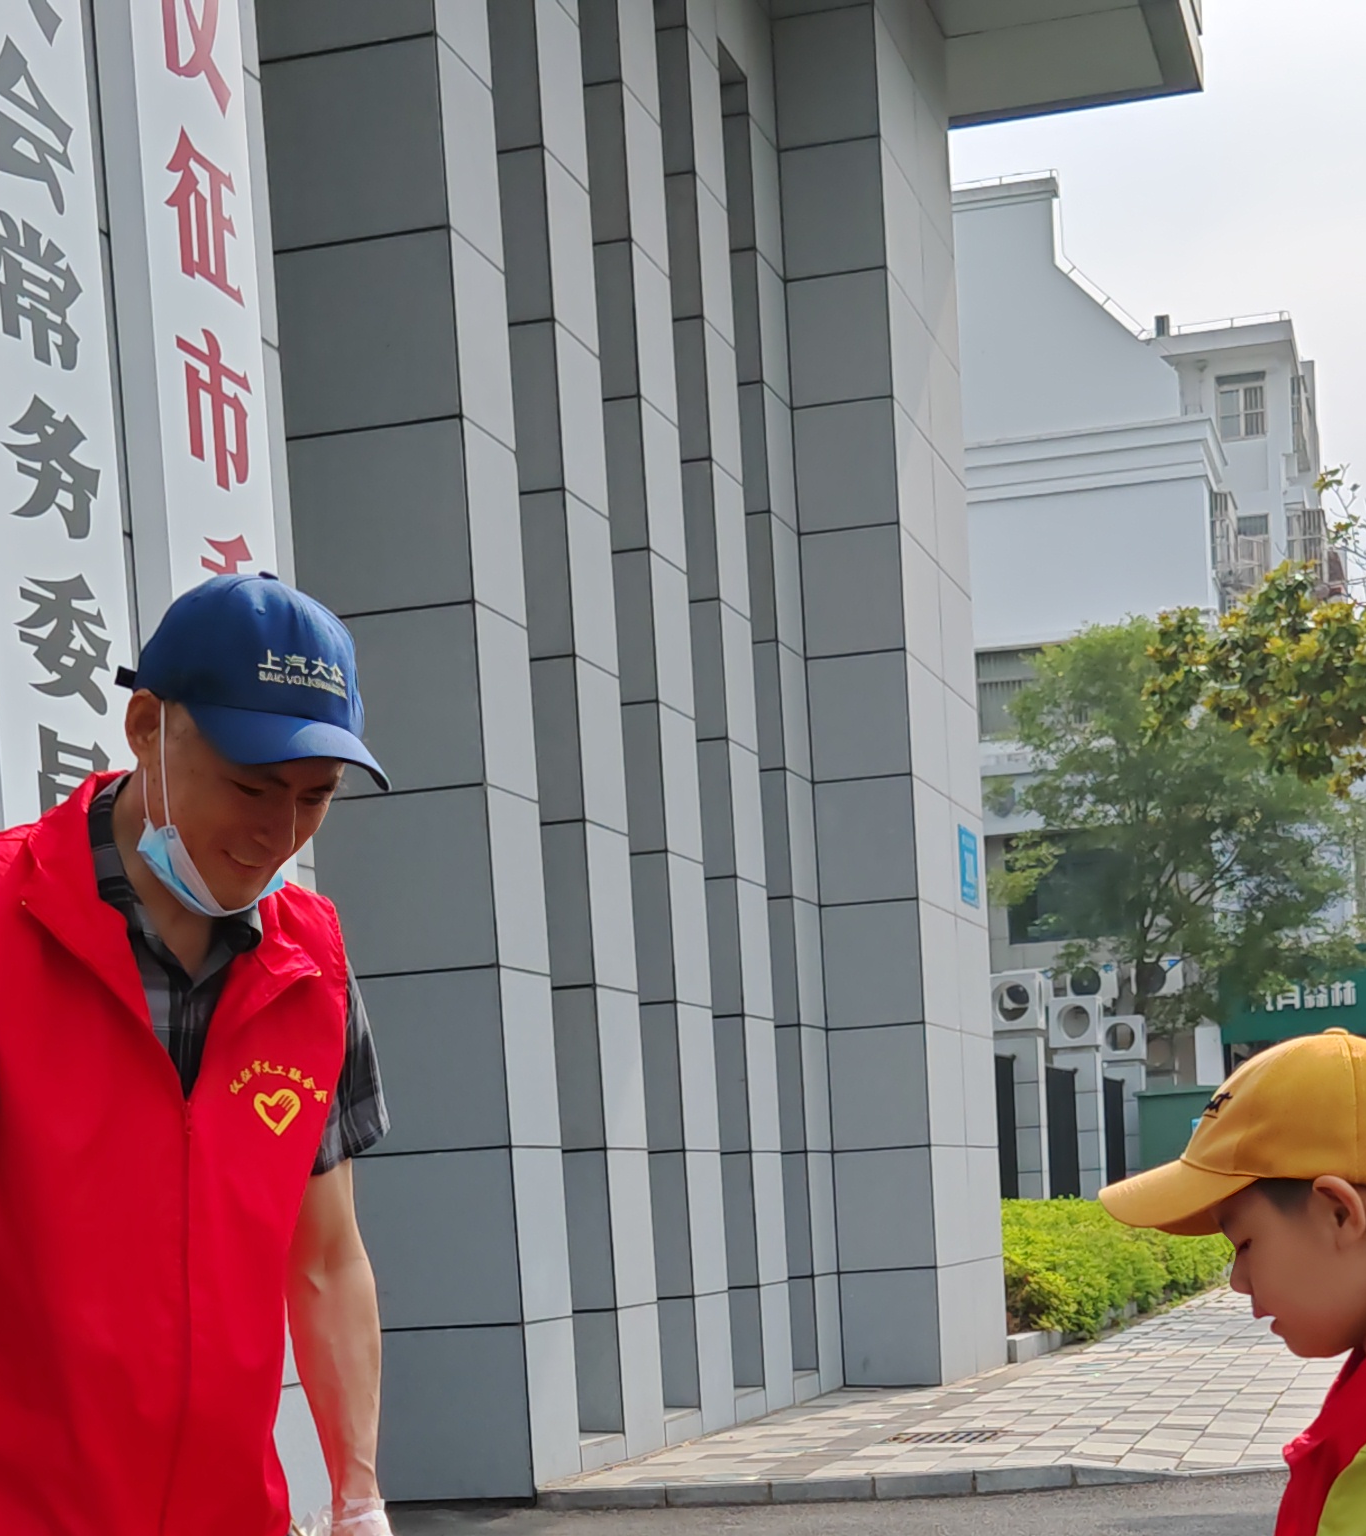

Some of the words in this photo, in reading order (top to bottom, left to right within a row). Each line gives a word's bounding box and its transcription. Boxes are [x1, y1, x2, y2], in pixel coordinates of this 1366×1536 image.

[161, 0, 253, 576] 仪征市
[257, 648, 346, 688] 上汽大众
[258, 670, 285, 684] SAIC
